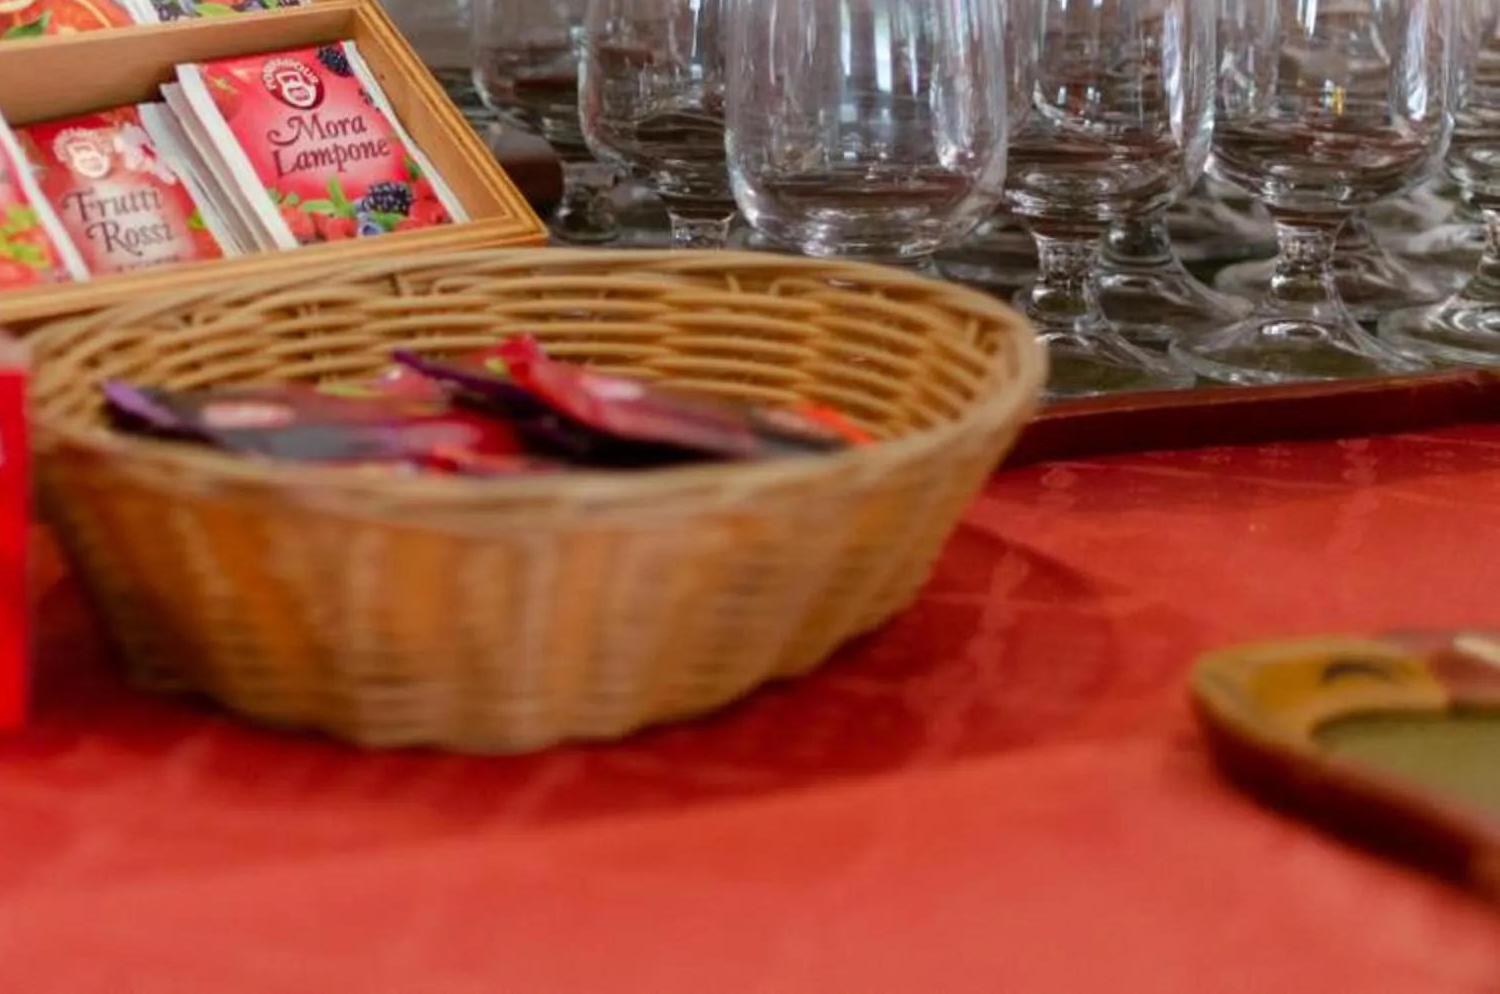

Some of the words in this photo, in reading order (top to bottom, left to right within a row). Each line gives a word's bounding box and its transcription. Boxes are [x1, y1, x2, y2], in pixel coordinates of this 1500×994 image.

[266, 111, 368, 147] Mora
[271, 137, 391, 179] Lampone
[62, 187, 163, 223] Frutti
